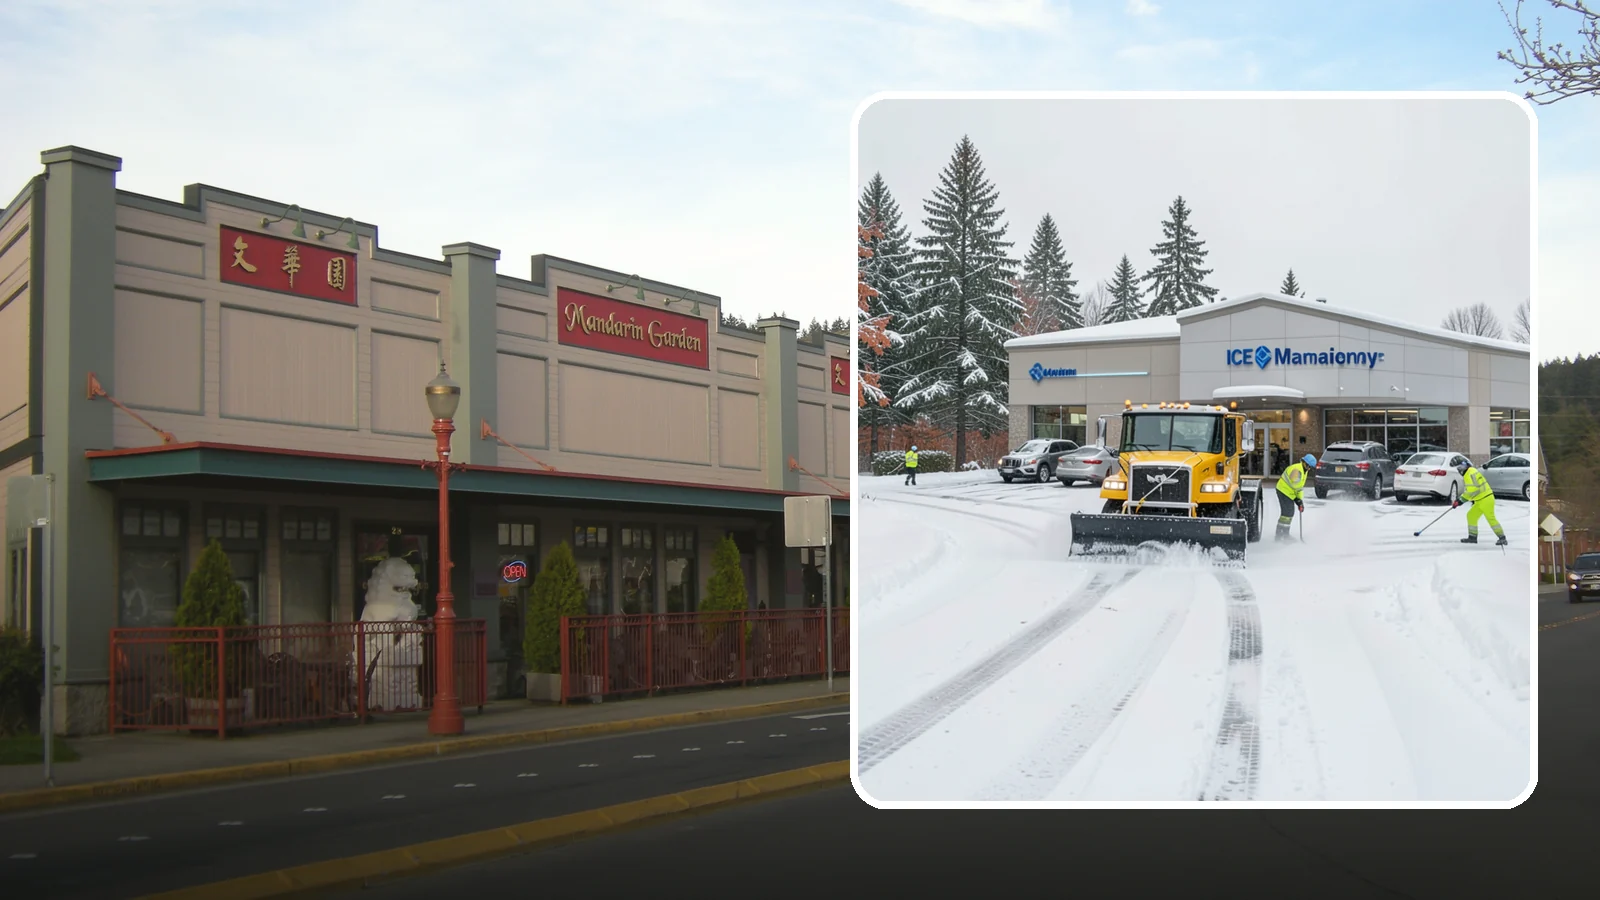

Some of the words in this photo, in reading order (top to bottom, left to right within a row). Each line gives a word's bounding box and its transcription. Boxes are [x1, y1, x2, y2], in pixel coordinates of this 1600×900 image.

[229, 234, 347, 291] 文華園
[564, 302, 644, 341] Mandarin
[648, 320, 702, 352] Garden
[1226, 348, 1254, 366] ICE
[503, 565, 527, 579] OPEN
